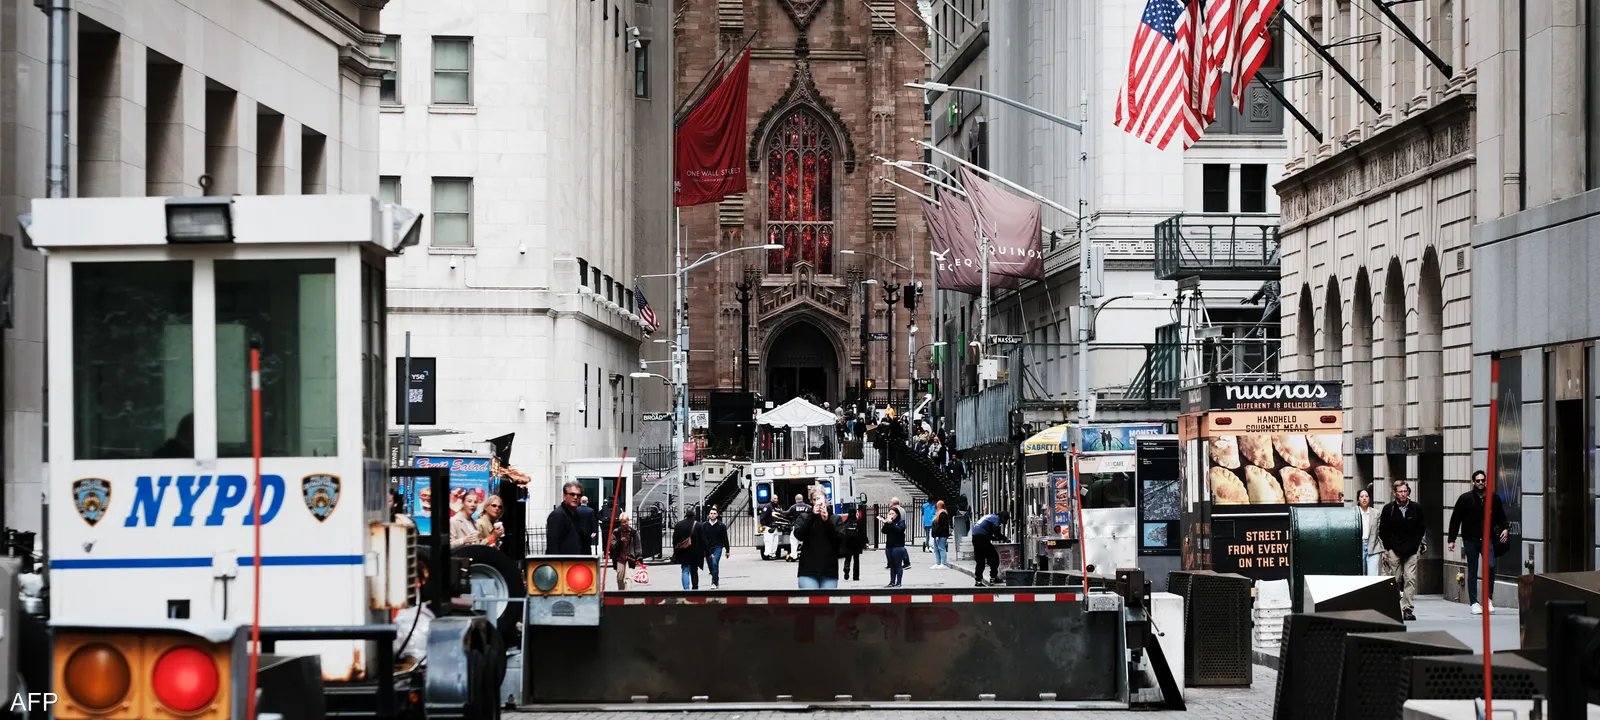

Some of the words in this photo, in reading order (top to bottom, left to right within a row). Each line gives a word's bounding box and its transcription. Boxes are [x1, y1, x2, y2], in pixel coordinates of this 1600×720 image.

[721, 167, 741, 176] STREET
[1236, 402, 1271, 410] DIFFERENT
[1283, 401, 1317, 409] DELICIOUS
[1257, 415, 1297, 424] HANDHELD
[1245, 424, 1280, 433] GOURMET
[1283, 423, 1309, 432] MEALS
[1026, 442, 1058, 451] SABRETT
[451, 458, 489, 471] Salad
[123, 474, 286, 527] NYPD
[1246, 531, 1282, 541] STREET
[1228, 544, 1254, 555] FROM
[1258, 543, 1289, 554] EVERY
[1238, 557, 1252, 568] ON
[1257, 557, 1275, 567] THE
[717, 605, 960, 643] STOP
